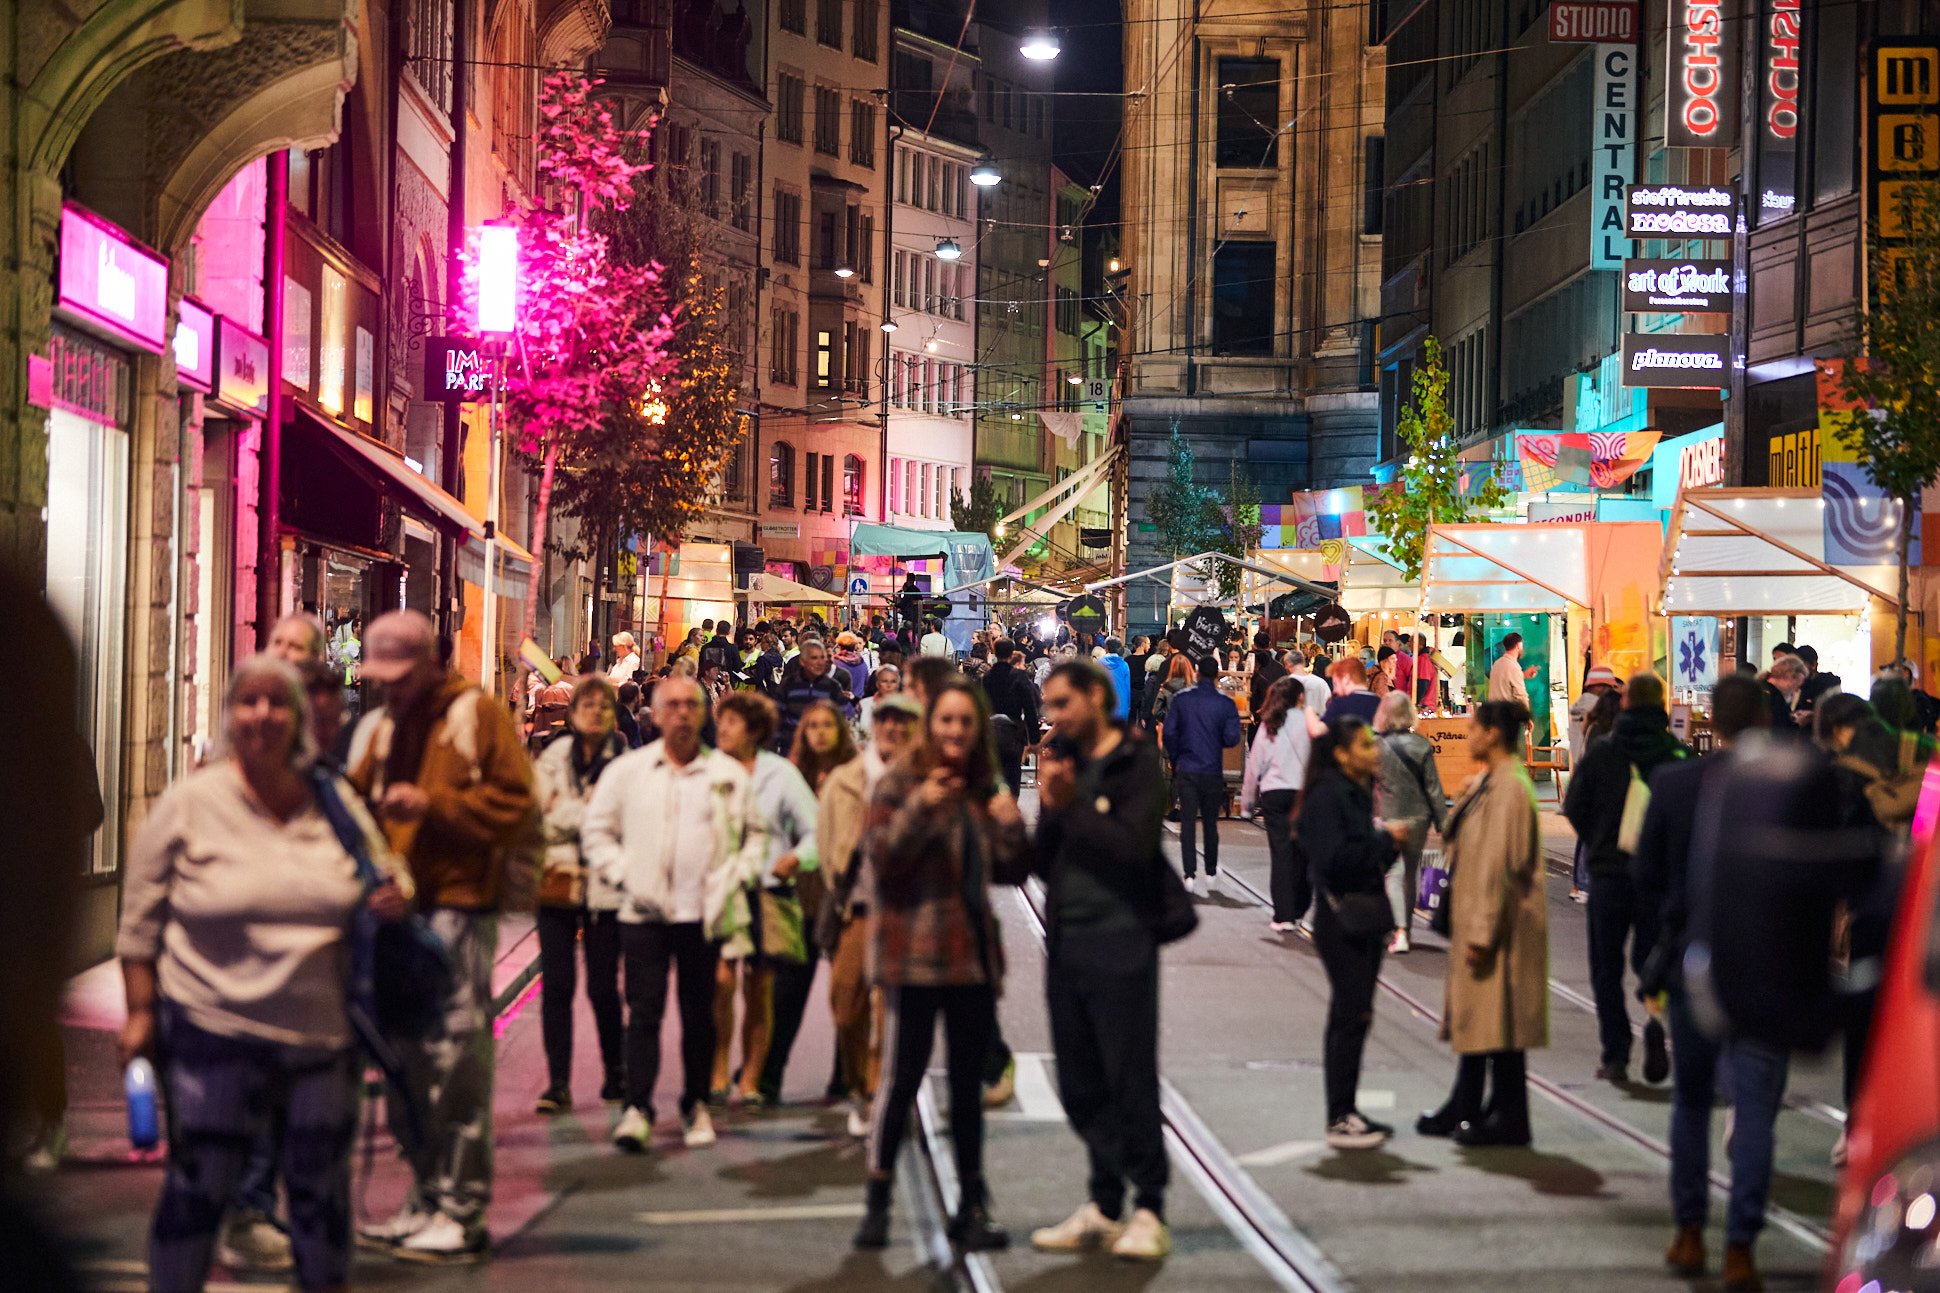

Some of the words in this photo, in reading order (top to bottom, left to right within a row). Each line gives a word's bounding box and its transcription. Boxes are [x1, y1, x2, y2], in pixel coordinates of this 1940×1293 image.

[1556, 5, 1632, 39] STUDIO
[1600, 52, 1629, 261] CENTRAL
[1631, 211, 1732, 233] modesa
[1628, 269, 1657, 292] art
[1658, 267, 1680, 293] of
[1681, 265, 1730, 293] work
[1089, 382, 1103, 396] 18
